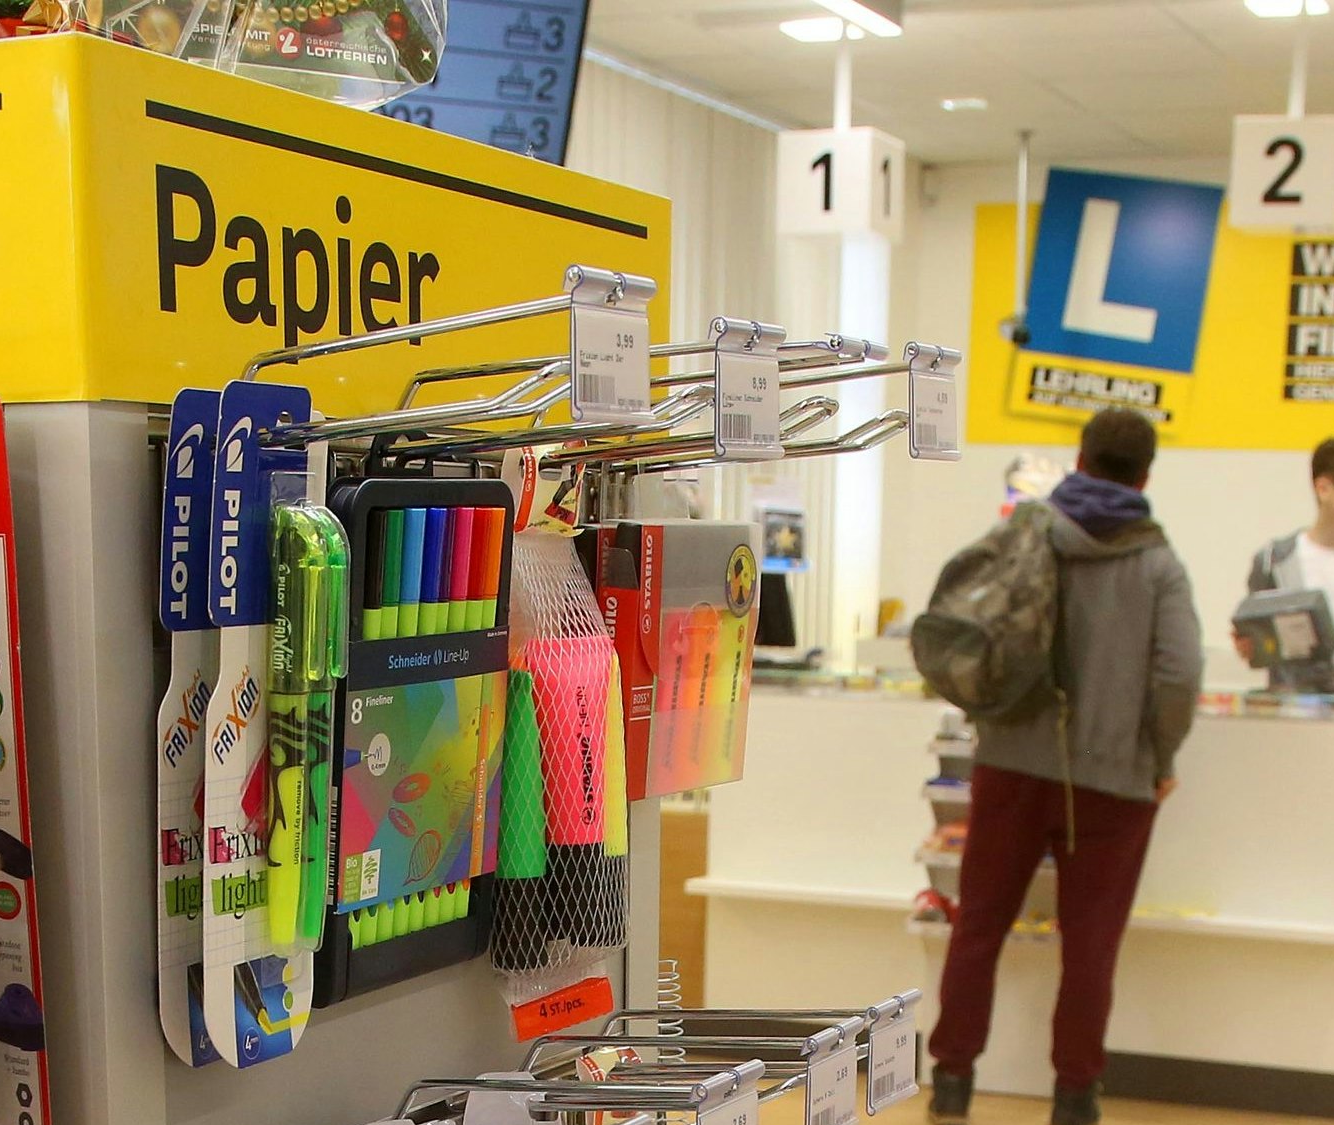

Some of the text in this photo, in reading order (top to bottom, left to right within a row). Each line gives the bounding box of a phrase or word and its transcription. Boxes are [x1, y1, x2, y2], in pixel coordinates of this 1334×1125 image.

[305, 46, 389, 65] LOTTERIEN
[810, 150, 833, 212] 1
[1261, 136, 1305, 204] 2
[155, 163, 441, 364] Papier
[1061, 197, 1159, 344] L
[616, 333, 634, 350] 3,99
[752, 376, 767, 391] 8,99
[169, 496, 192, 620] PILOT
[220, 489, 242, 616] PILOT
[643, 533, 654, 611] STABILO
[277, 575, 287, 608] PILOT
[388, 648, 470, 669] Schneider Line-Up
[351, 693, 395, 724] 8 Fineliner
[221, 869, 266, 918] light
